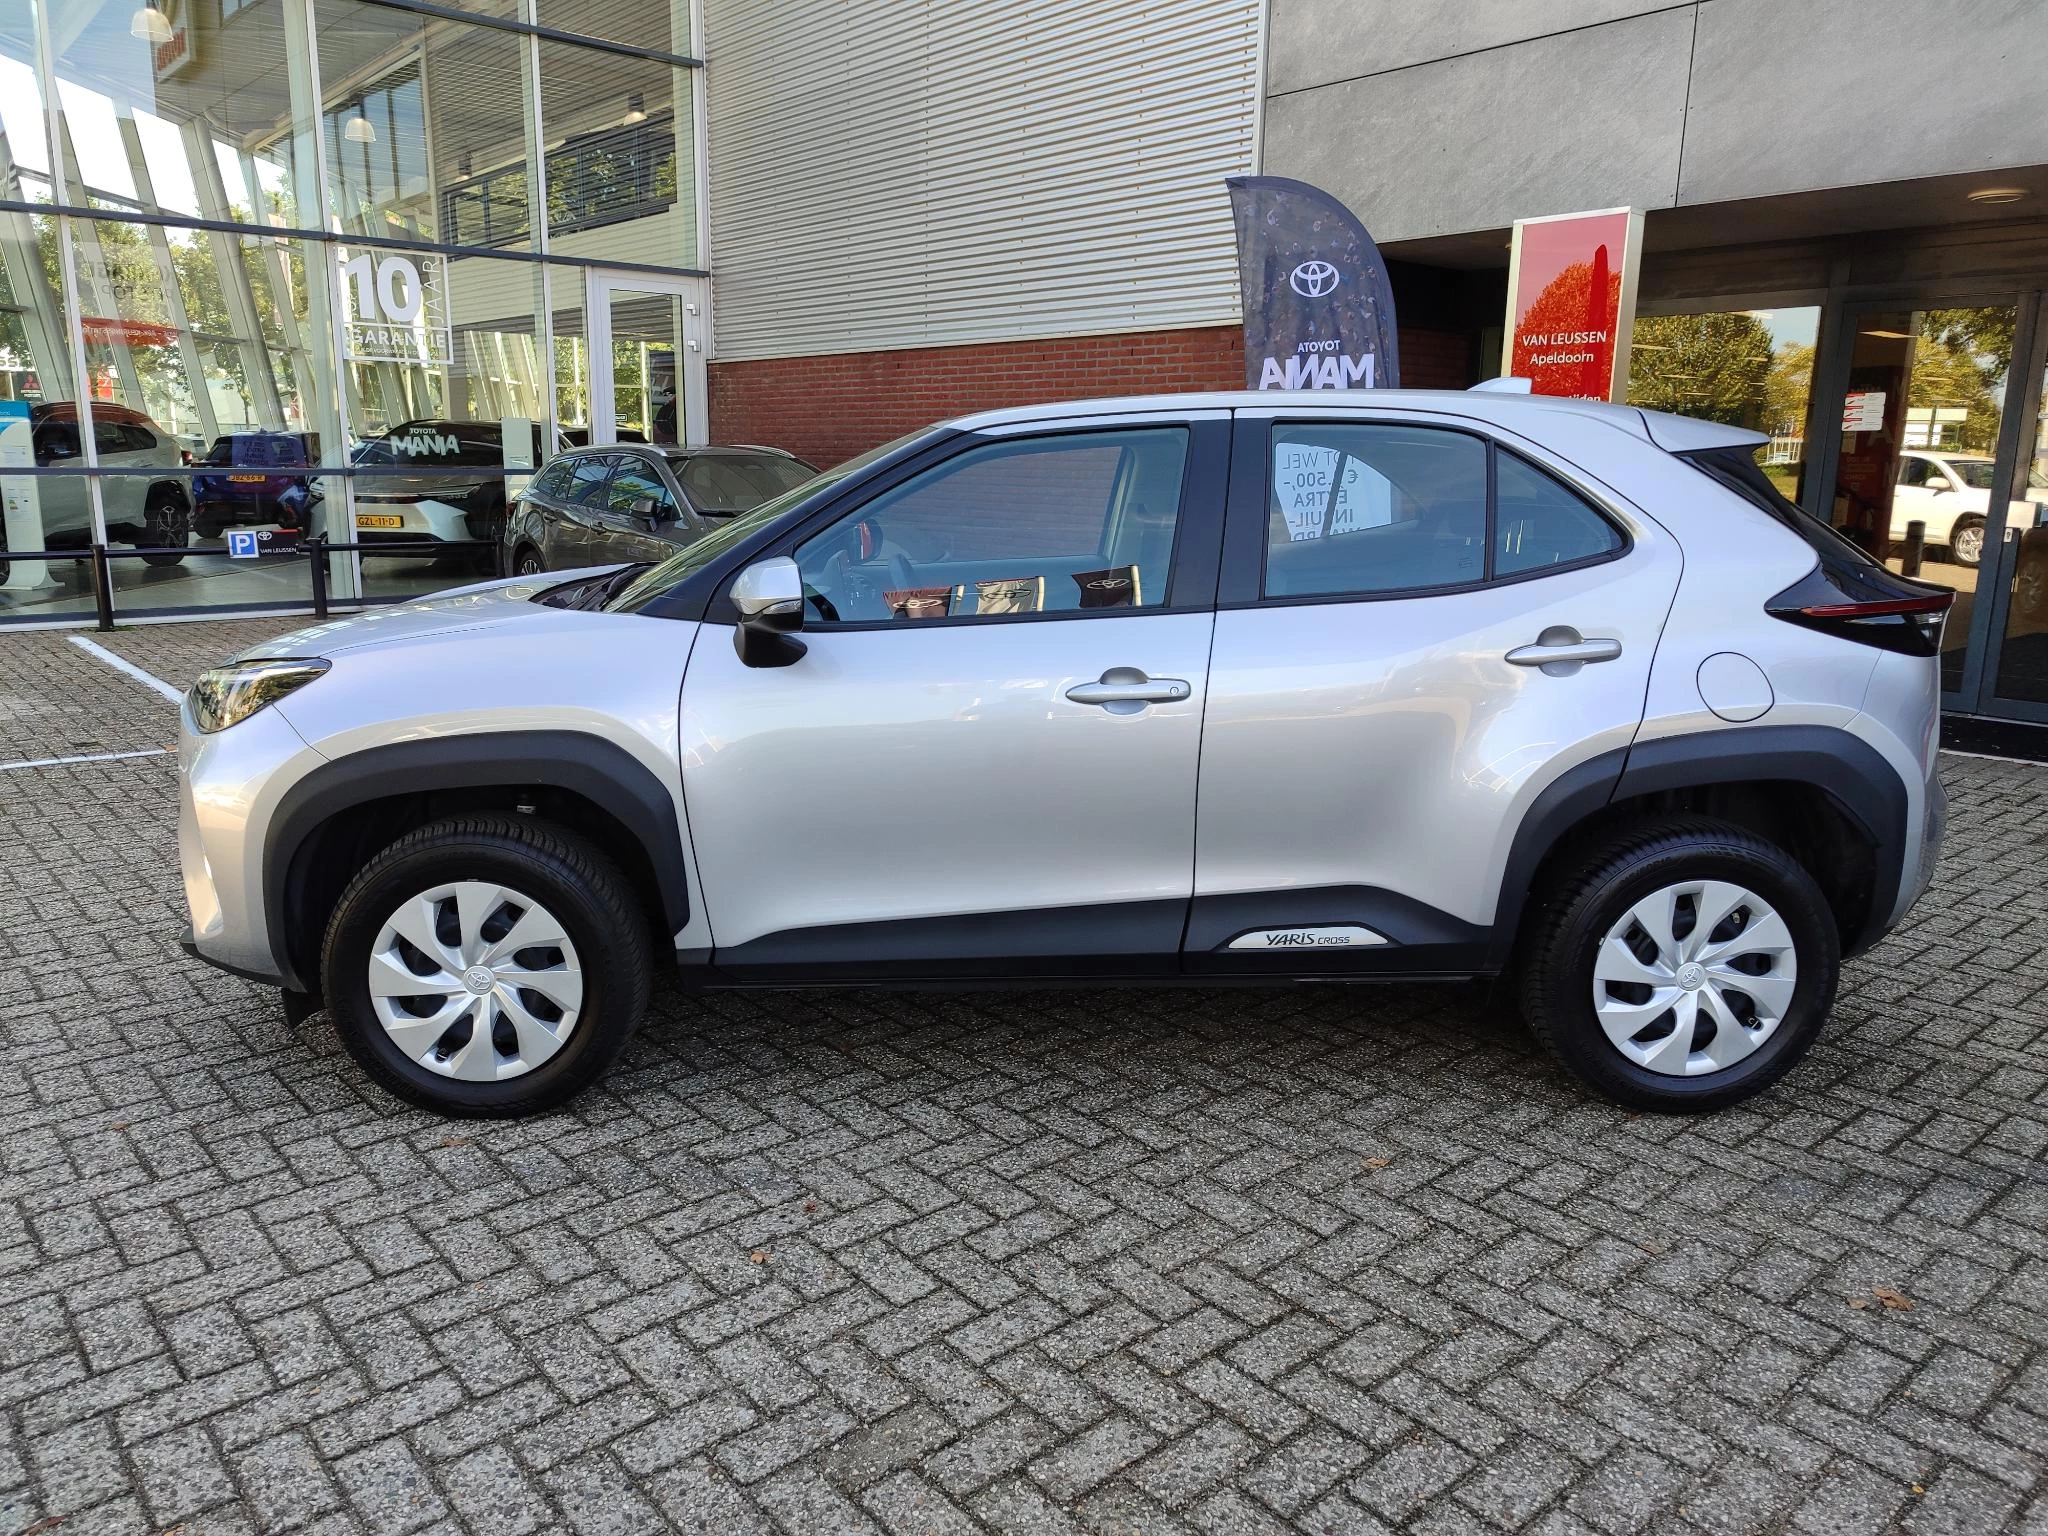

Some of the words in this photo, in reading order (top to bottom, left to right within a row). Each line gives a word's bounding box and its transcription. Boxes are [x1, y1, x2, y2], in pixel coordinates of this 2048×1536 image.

[346, 253, 422, 322] 10
[422, 260, 445, 325] JAAR
[1522, 334, 1548, 347] VAN
[1550, 331, 1607, 345] LEUSSEN
[1530, 351, 1594, 366] Apeldoorn
[389, 434, 461, 457] MANIA
[358, 515, 395, 526] GZL-11-D
[235, 535, 251, 555] P
[1265, 932, 1315, 946] YARIS
[1317, 936, 1350, 945] CROSS
